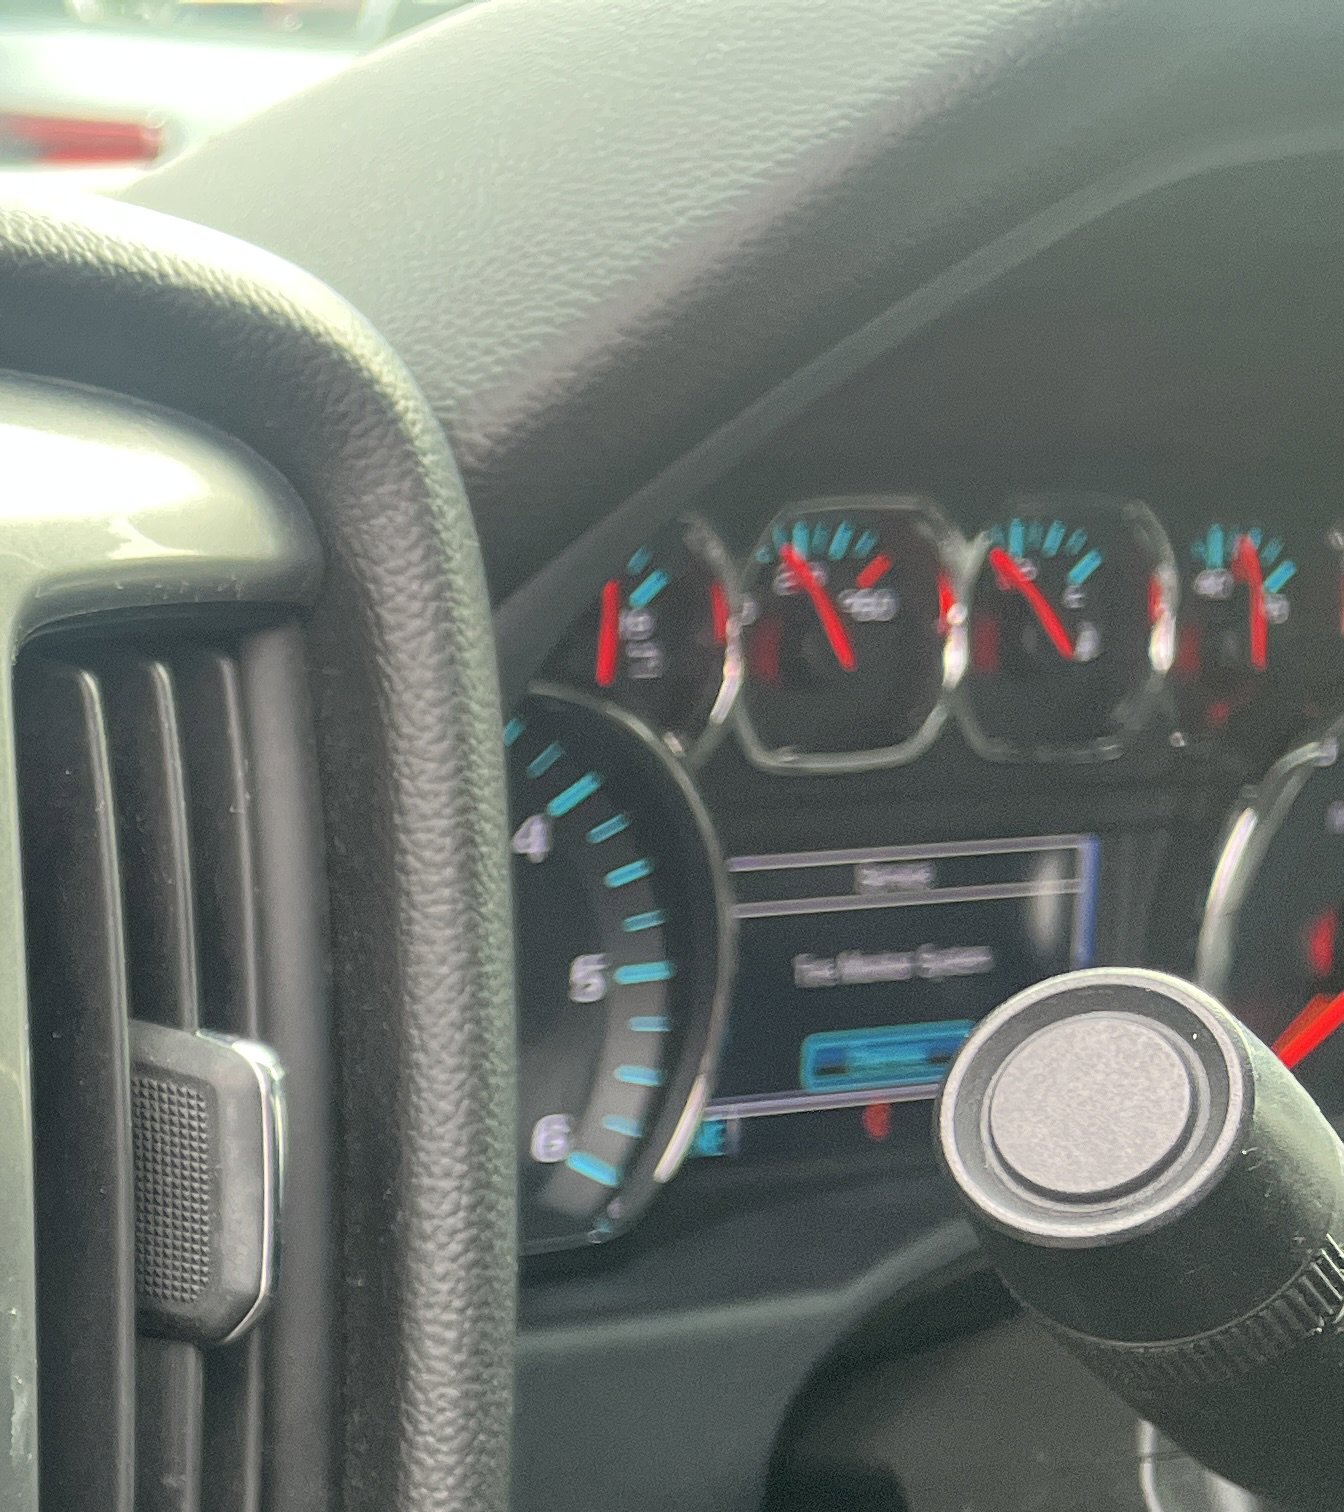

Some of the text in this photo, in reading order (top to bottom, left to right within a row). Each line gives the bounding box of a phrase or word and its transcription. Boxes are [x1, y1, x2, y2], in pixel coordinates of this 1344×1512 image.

[512, 815, 550, 863] 4
[569, 953, 610, 1003] 5
[530, 1112, 572, 1163] 6
